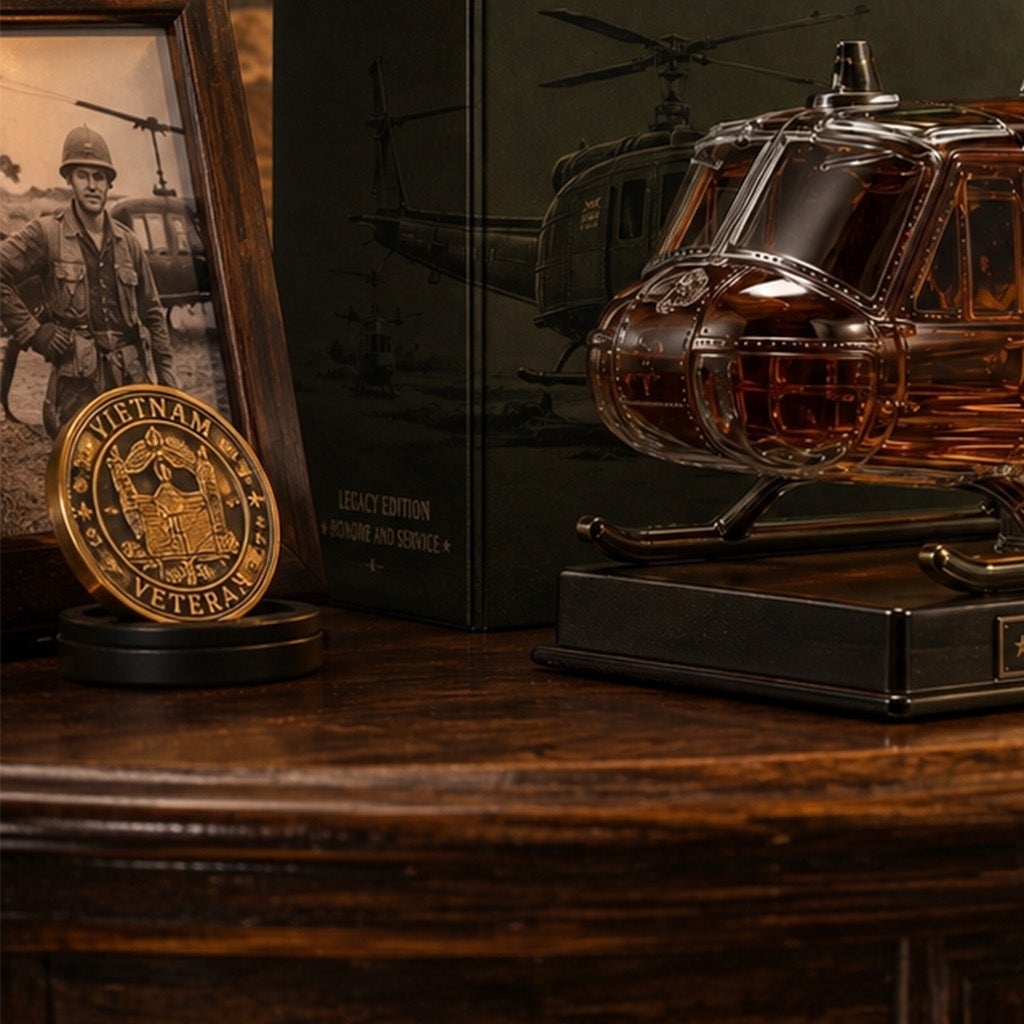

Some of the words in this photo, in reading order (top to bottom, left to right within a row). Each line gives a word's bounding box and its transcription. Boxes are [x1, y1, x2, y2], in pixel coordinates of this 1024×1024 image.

[89, 397, 213, 439] VIETNAM
[338, 489, 380, 515] LEGACY
[382, 495, 431, 522] EDITION
[374, 527, 395, 547] AND
[135, 572, 253, 616] VETERAN
